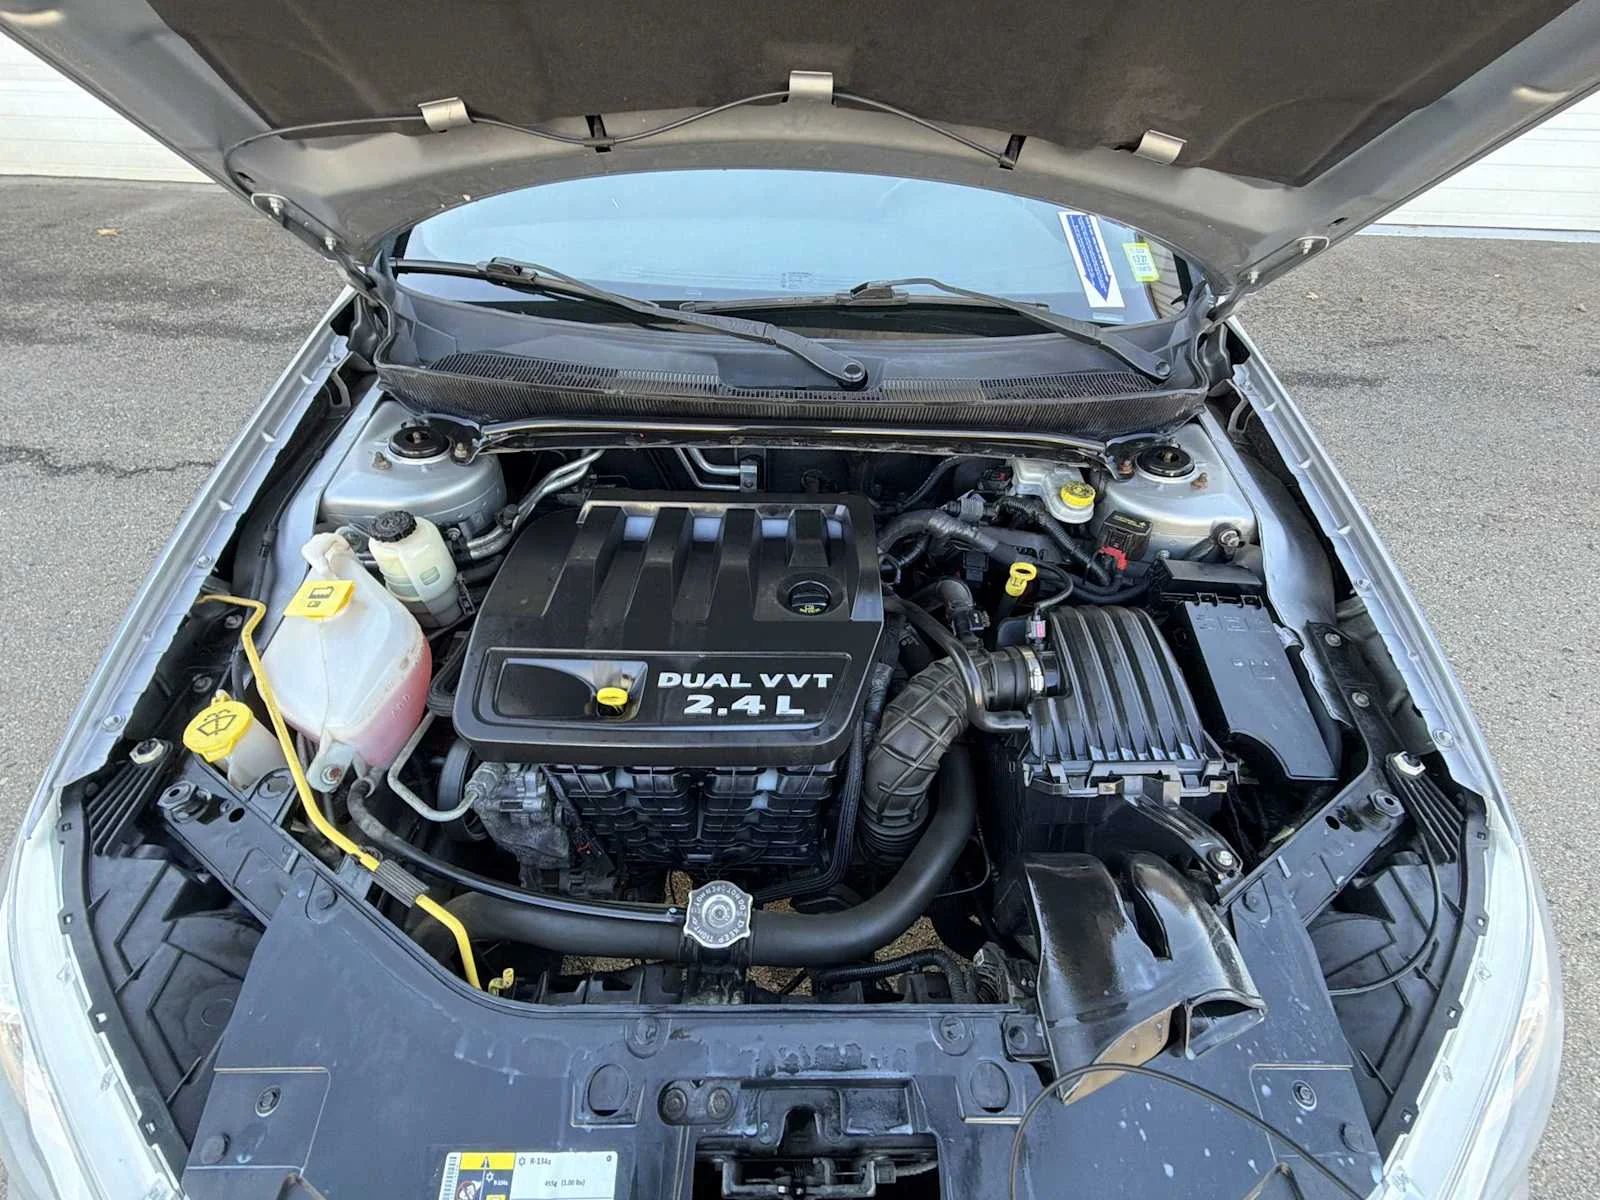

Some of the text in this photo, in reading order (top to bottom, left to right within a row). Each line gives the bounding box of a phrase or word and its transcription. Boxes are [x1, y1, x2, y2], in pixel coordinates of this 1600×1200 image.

[657, 672, 833, 688] DUAL VVT
[683, 694, 805, 716] 2.4 L
[694, 925, 738, 943] KEEP TIGHT
